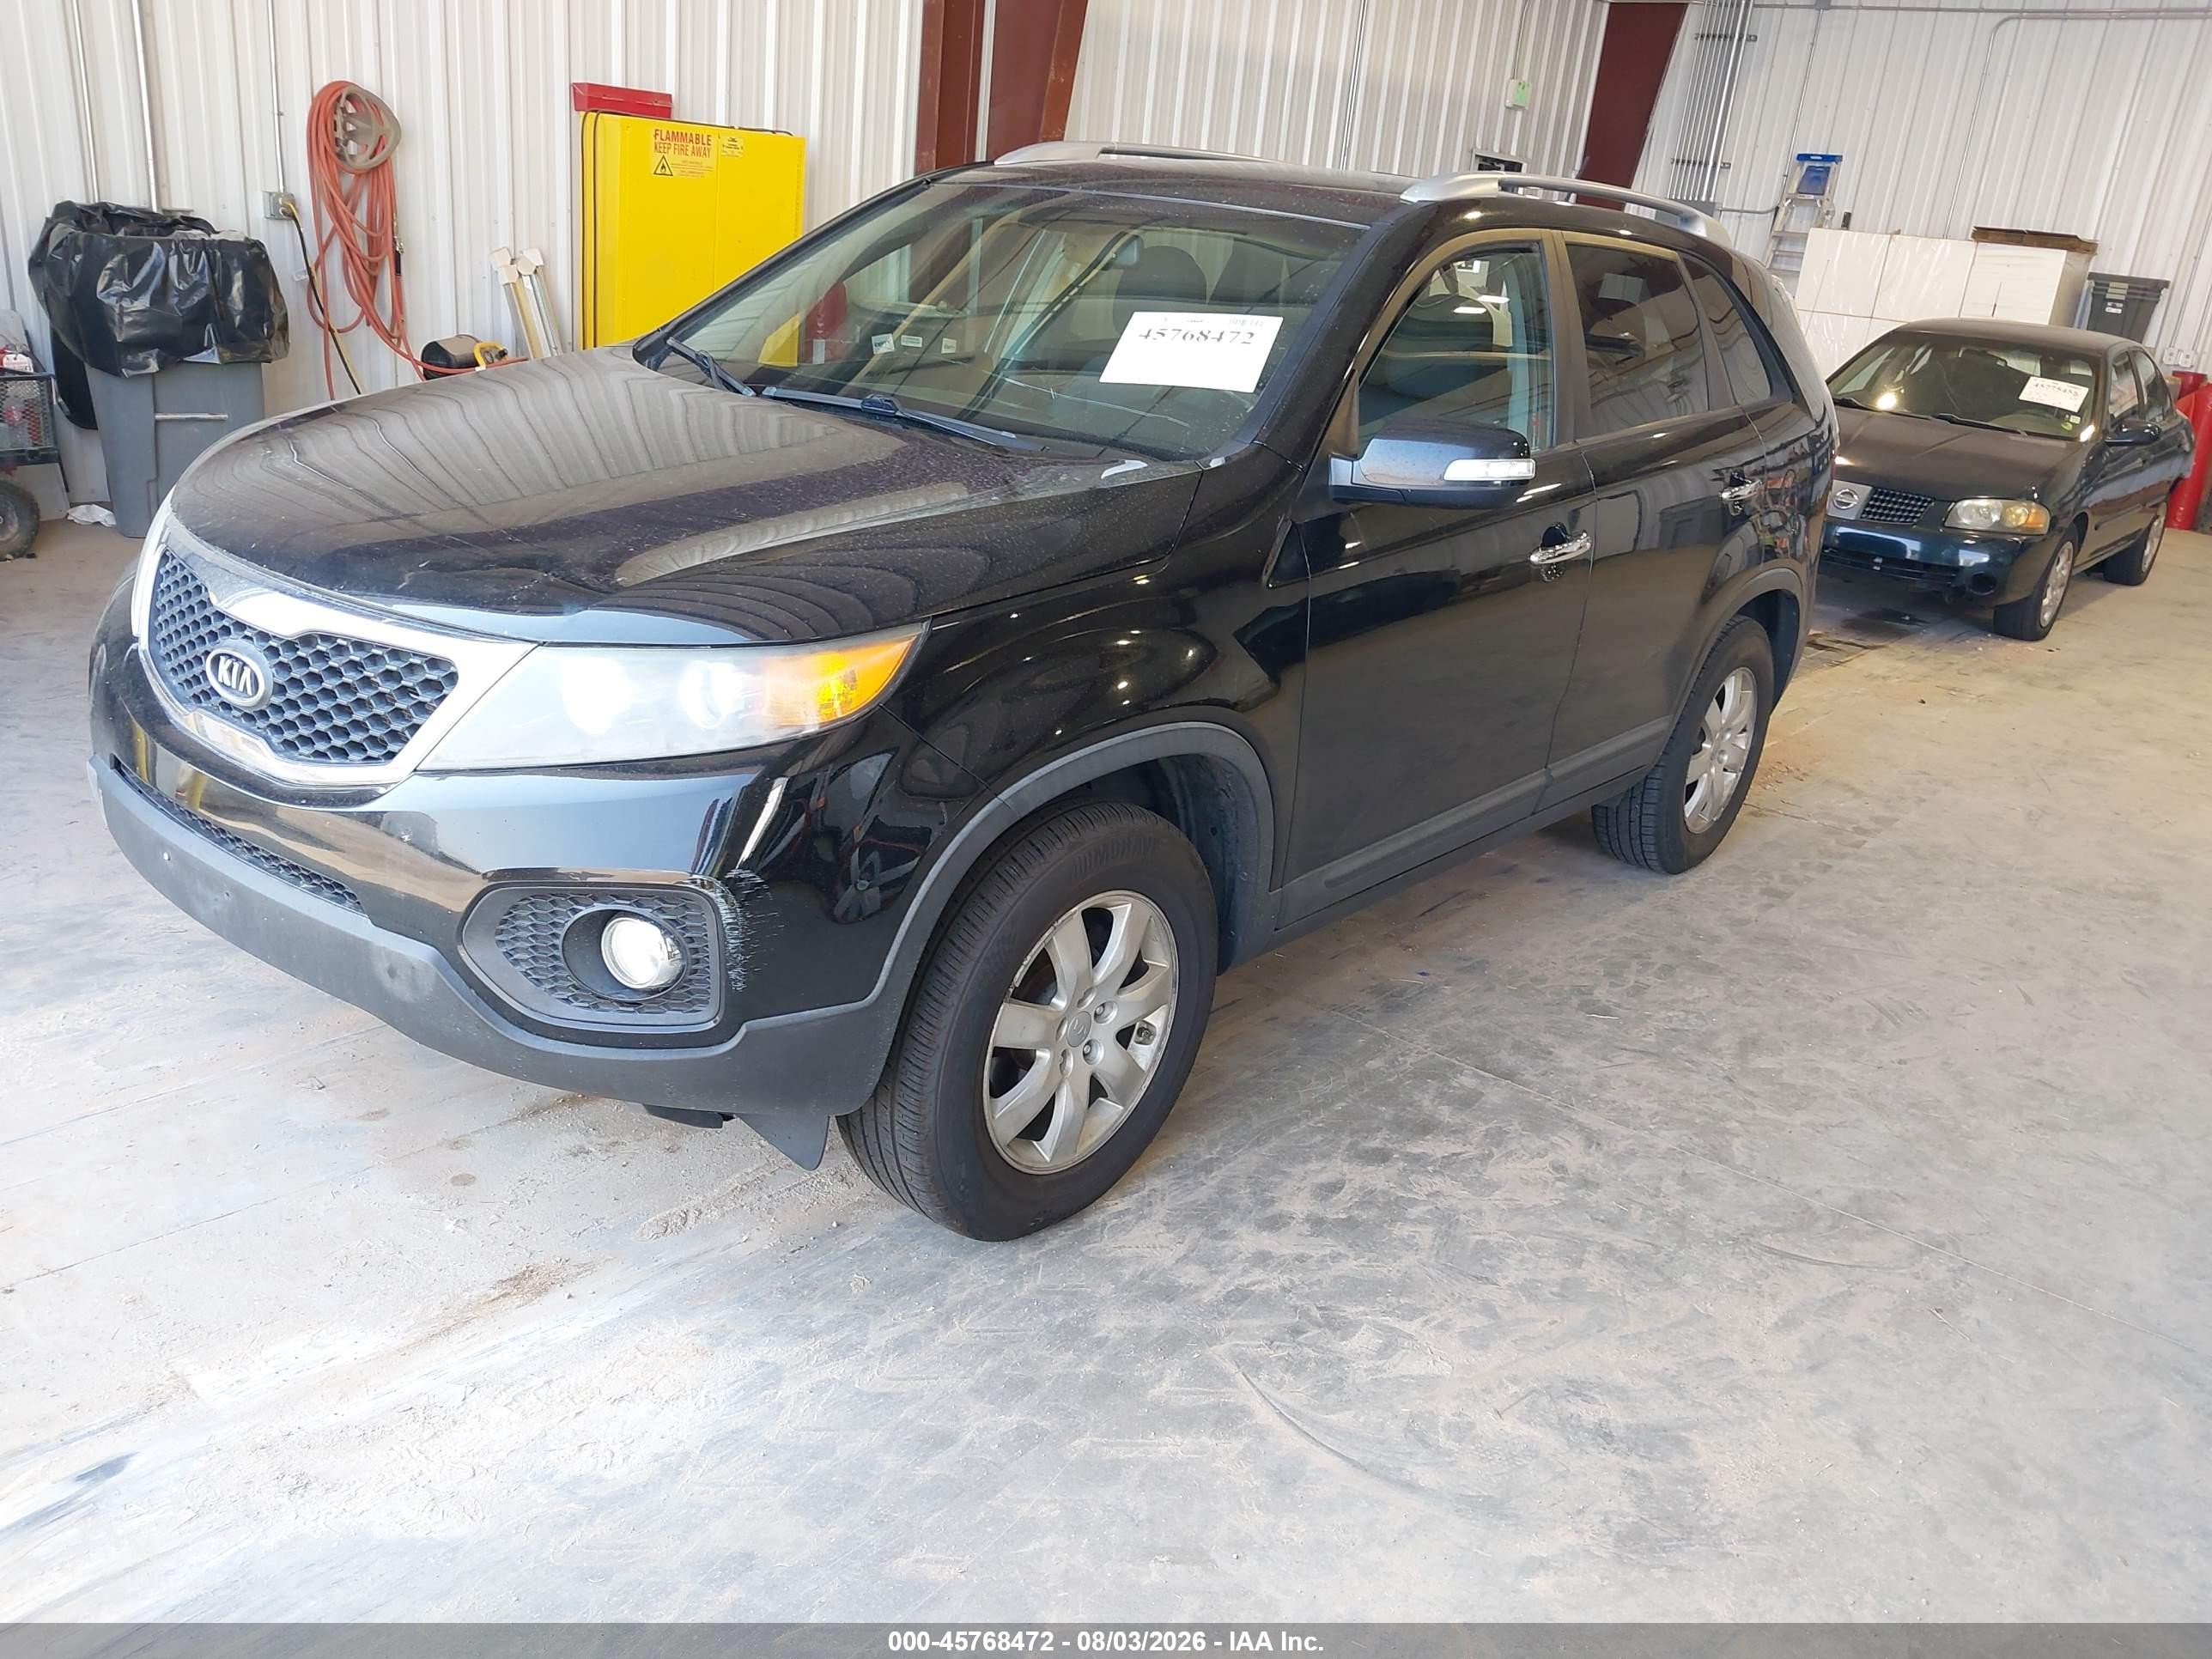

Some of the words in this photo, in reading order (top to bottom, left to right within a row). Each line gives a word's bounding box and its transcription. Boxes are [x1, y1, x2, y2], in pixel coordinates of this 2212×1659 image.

[653, 129, 713, 146] FLAMMABLE
[653, 142, 672, 155] KEEP
[673, 143, 690, 156] FIRE
[690, 145, 712, 159] AWAY
[1138, 328, 1255, 345] 45768472
[217, 654, 253, 696] KIA
